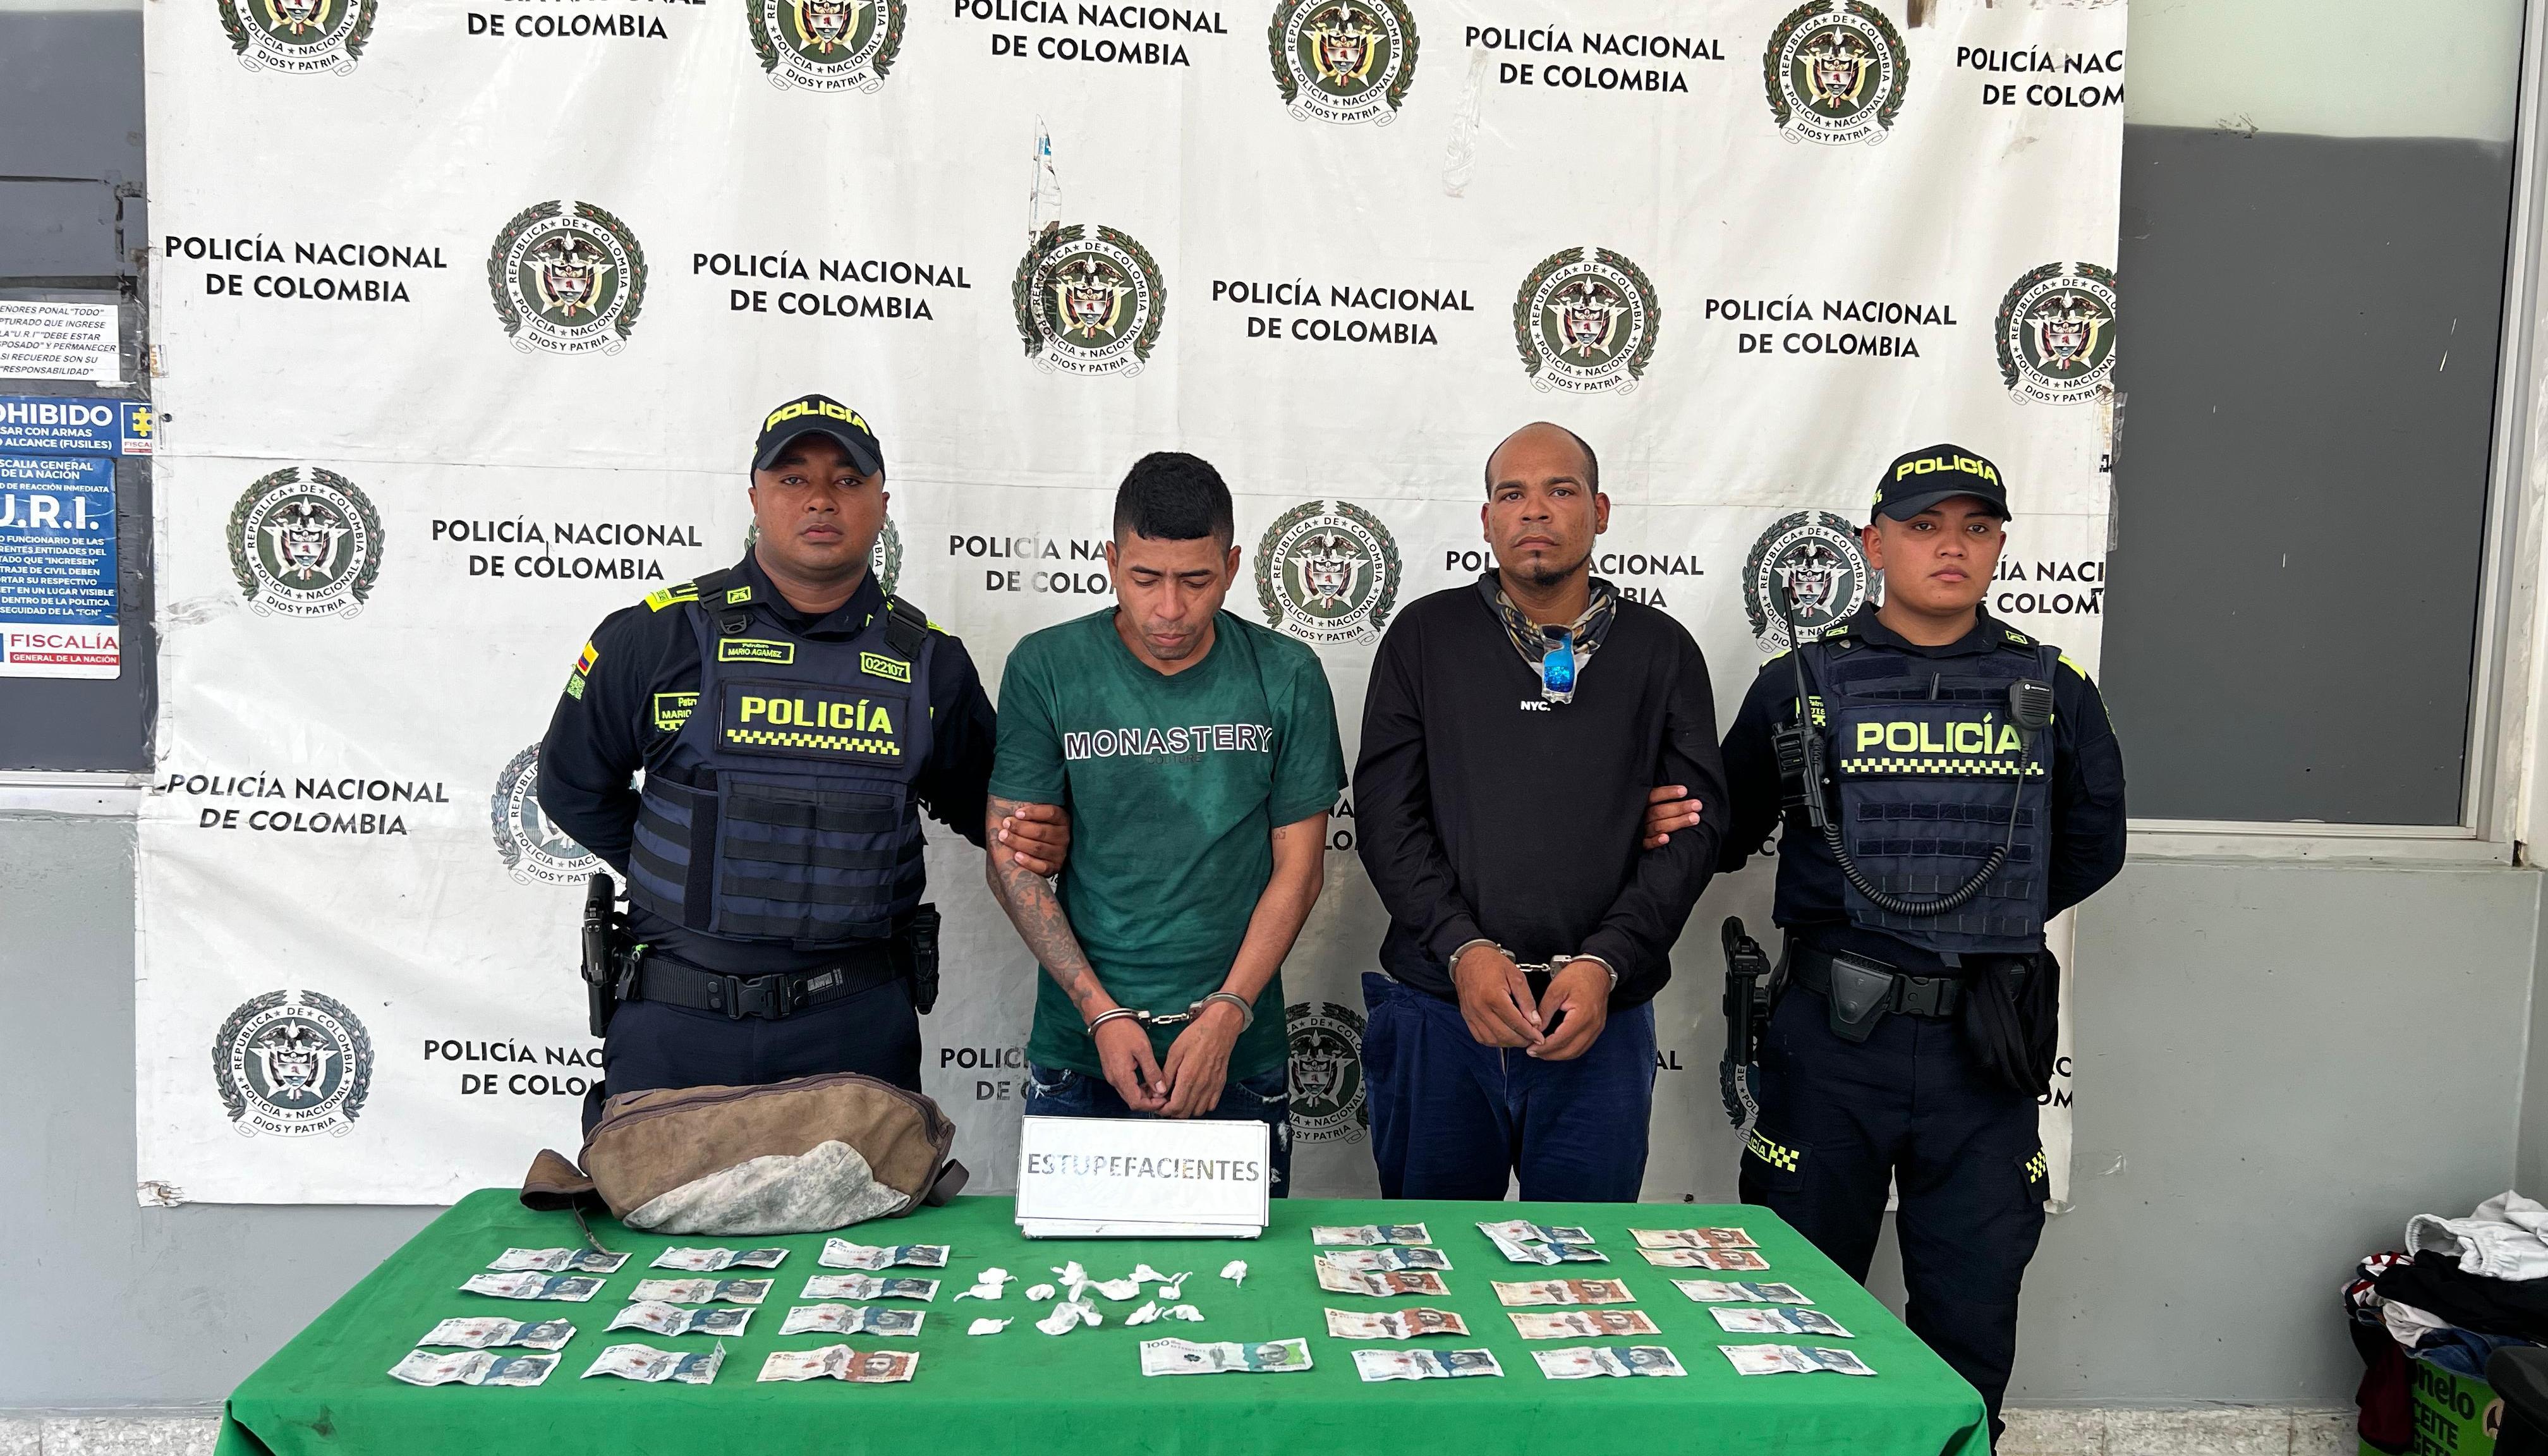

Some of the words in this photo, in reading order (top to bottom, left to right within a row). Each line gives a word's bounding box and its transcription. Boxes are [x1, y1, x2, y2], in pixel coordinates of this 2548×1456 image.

[468, 13, 504, 36] DE
[515, 14, 669, 39] COLOMBIA
[1079, 3, 1228, 33] NACIONAL
[993, 34, 1028, 57] DE
[1038, 37, 1191, 66] COLOMBIA
[1466, 23, 1571, 53] POLICÍA
[1583, 32, 1725, 61] NACIONAL
[1833, 15, 1848, 23] DE
[1860, 23, 1890, 82] COLOMBIA
[1956, 45, 2055, 73] POLICÍA
[1500, 63, 1534, 85] DE
[1543, 65, 1689, 93] COLOMBIA
[1983, 83, 2016, 105] DE
[2026, 83, 2123, 107] COLOM
[1835, 94, 1885, 128] NACIONAL
[1833, 126, 1872, 142] PATRIA
[166, 233, 285, 263] POLICÍA
[296, 242, 447, 268] NACIONAL
[693, 250, 809, 280] POLICÍA
[820, 259, 971, 289] NACIONAL
[206, 274, 243, 296] DE
[254, 275, 410, 303] COLOMBIA
[1213, 278, 1321, 306] POLICÍA
[1332, 286, 1474, 312] NACIONAL
[0, 304, 37, 313] EÑORES
[39, 307, 69, 315] PONAL
[731, 290, 767, 312] DE
[778, 293, 933, 320] COLOMBIA
[1705, 294, 1813, 321] POLICÍA
[1823, 301, 1957, 325] NACIONAL
[65, 320, 106, 329] INGRESE
[1247, 317, 1282, 339] DE
[1291, 318, 1438, 345] COLOMBIA
[11, 353, 62, 362] RECUERDE
[53, 343, 116, 352] PERMANECER
[1738, 333, 1773, 353] DE
[1783, 333, 1920, 358] COLOMBIA
[0, 403, 112, 427] HIBIDO
[0, 427, 23, 435] SAR
[25, 428, 49, 436] CON
[51, 428, 92, 437] ARMAS
[4, 438, 58, 447] ALCANCE
[59, 439, 112, 450] (FUSILES)
[2, 469, 16, 477] DE
[19, 470, 33, 478] LA
[35, 469, 80, 480] NACIÓN
[40, 461, 94, 471] GENERAL
[1896, 454, 1998, 486] POLICÍA
[20, 483, 62, 491] REACCIÓN
[63, 485, 109, 493] INMEDIATA
[7, 536, 70, 544] FUNCIONARIO
[432, 515, 545, 543] POLICÍA
[555, 523, 702, 547] NACIONAL
[23, 557, 44, 565] QUE
[35, 547, 87, 555] ENTIDADES
[470, 555, 504, 578] DE
[514, 554, 664, 580] COLOMBIA
[1587, 554, 1704, 576] ACIONAL
[2037, 561, 2104, 581] NACI
[40, 578, 97, 586] RESPECTIVO
[987, 571, 1021, 592] DE
[1031, 571, 1108, 595] COLO
[0, 606, 46, 615] SEGUIDAD
[1998, 592, 2100, 614] COLOM
[11, 633, 119, 650] FISCALÍA
[83, 655, 117, 663] NACIÓN
[865, 657, 905, 677] 022107
[741, 696, 894, 734] POLICÍA
[1520, 700, 1551, 712] NYC.
[1064, 724, 1272, 760] MONASTERY
[1857, 712, 2021, 755] POLICÍA
[1147, 753, 1201, 765] COUTURE
[167, 770, 286, 798] POLICÍA
[296, 779, 449, 803] NACIONAL
[200, 808, 240, 829] DE
[250, 810, 407, 835] COLOMBIA
[288, 1007, 304, 1016] DE
[317, 1015, 353, 1074] COLOMBIA
[425, 1038, 537, 1064] POLICÍA
[941, 1048, 1029, 1068] POLIC
[462, 1074, 498, 1095] DE
[509, 1074, 587, 1096] COLO
[976, 1081, 1010, 1100] DE
[296, 1085, 349, 1119] NACIONAL
[295, 1117, 337, 1134] PATRIA
[1027, 1153, 1259, 1182] ESTUPEFACIENTES
[1146, 1340, 1169, 1349] 100
[2418, 1364, 2475, 1421] nelo
